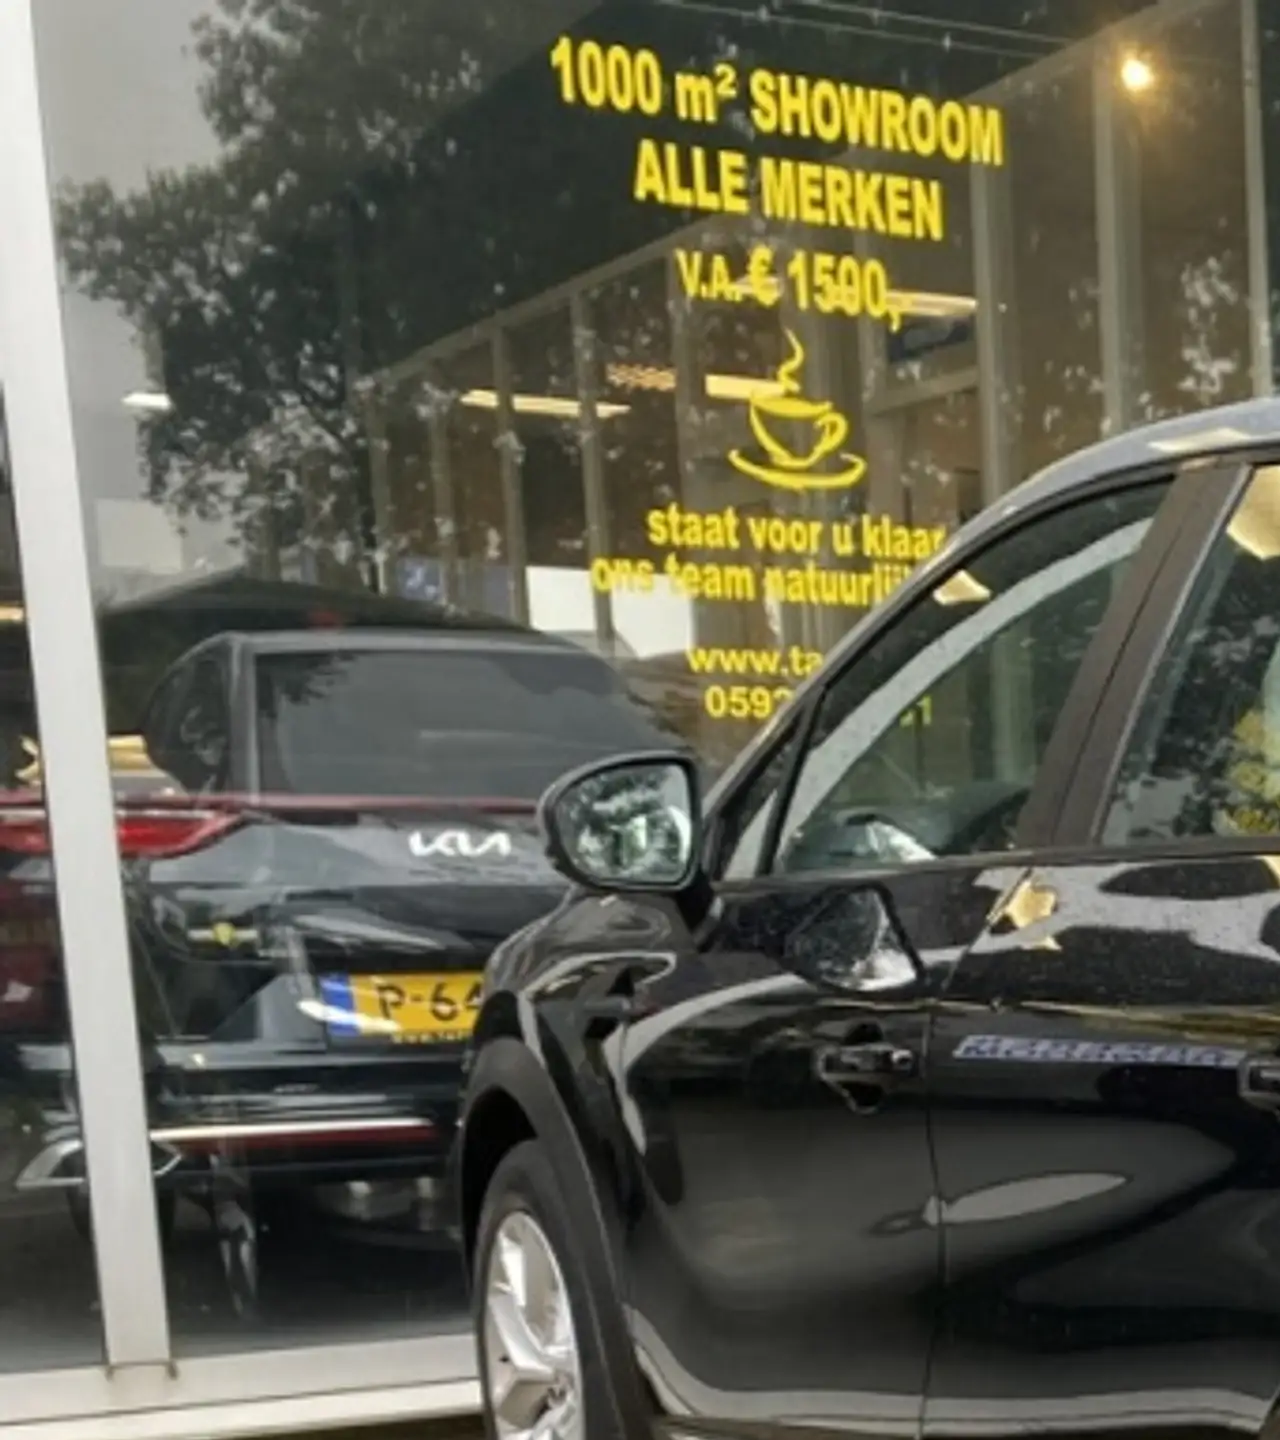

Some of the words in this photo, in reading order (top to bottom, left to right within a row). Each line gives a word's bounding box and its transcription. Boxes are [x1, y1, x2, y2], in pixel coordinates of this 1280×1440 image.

[550, 36, 662, 115] 1000
[750, 68, 1003, 165] SHOWROOM
[634, 138, 749, 214] ALLE
[760, 157, 943, 240] MERKEN
[646, 502, 740, 549] staat
[748, 515, 822, 552] voor
[832, 522, 854, 557] u
[591, 556, 654, 592] ons
[664, 552, 755, 600] team
